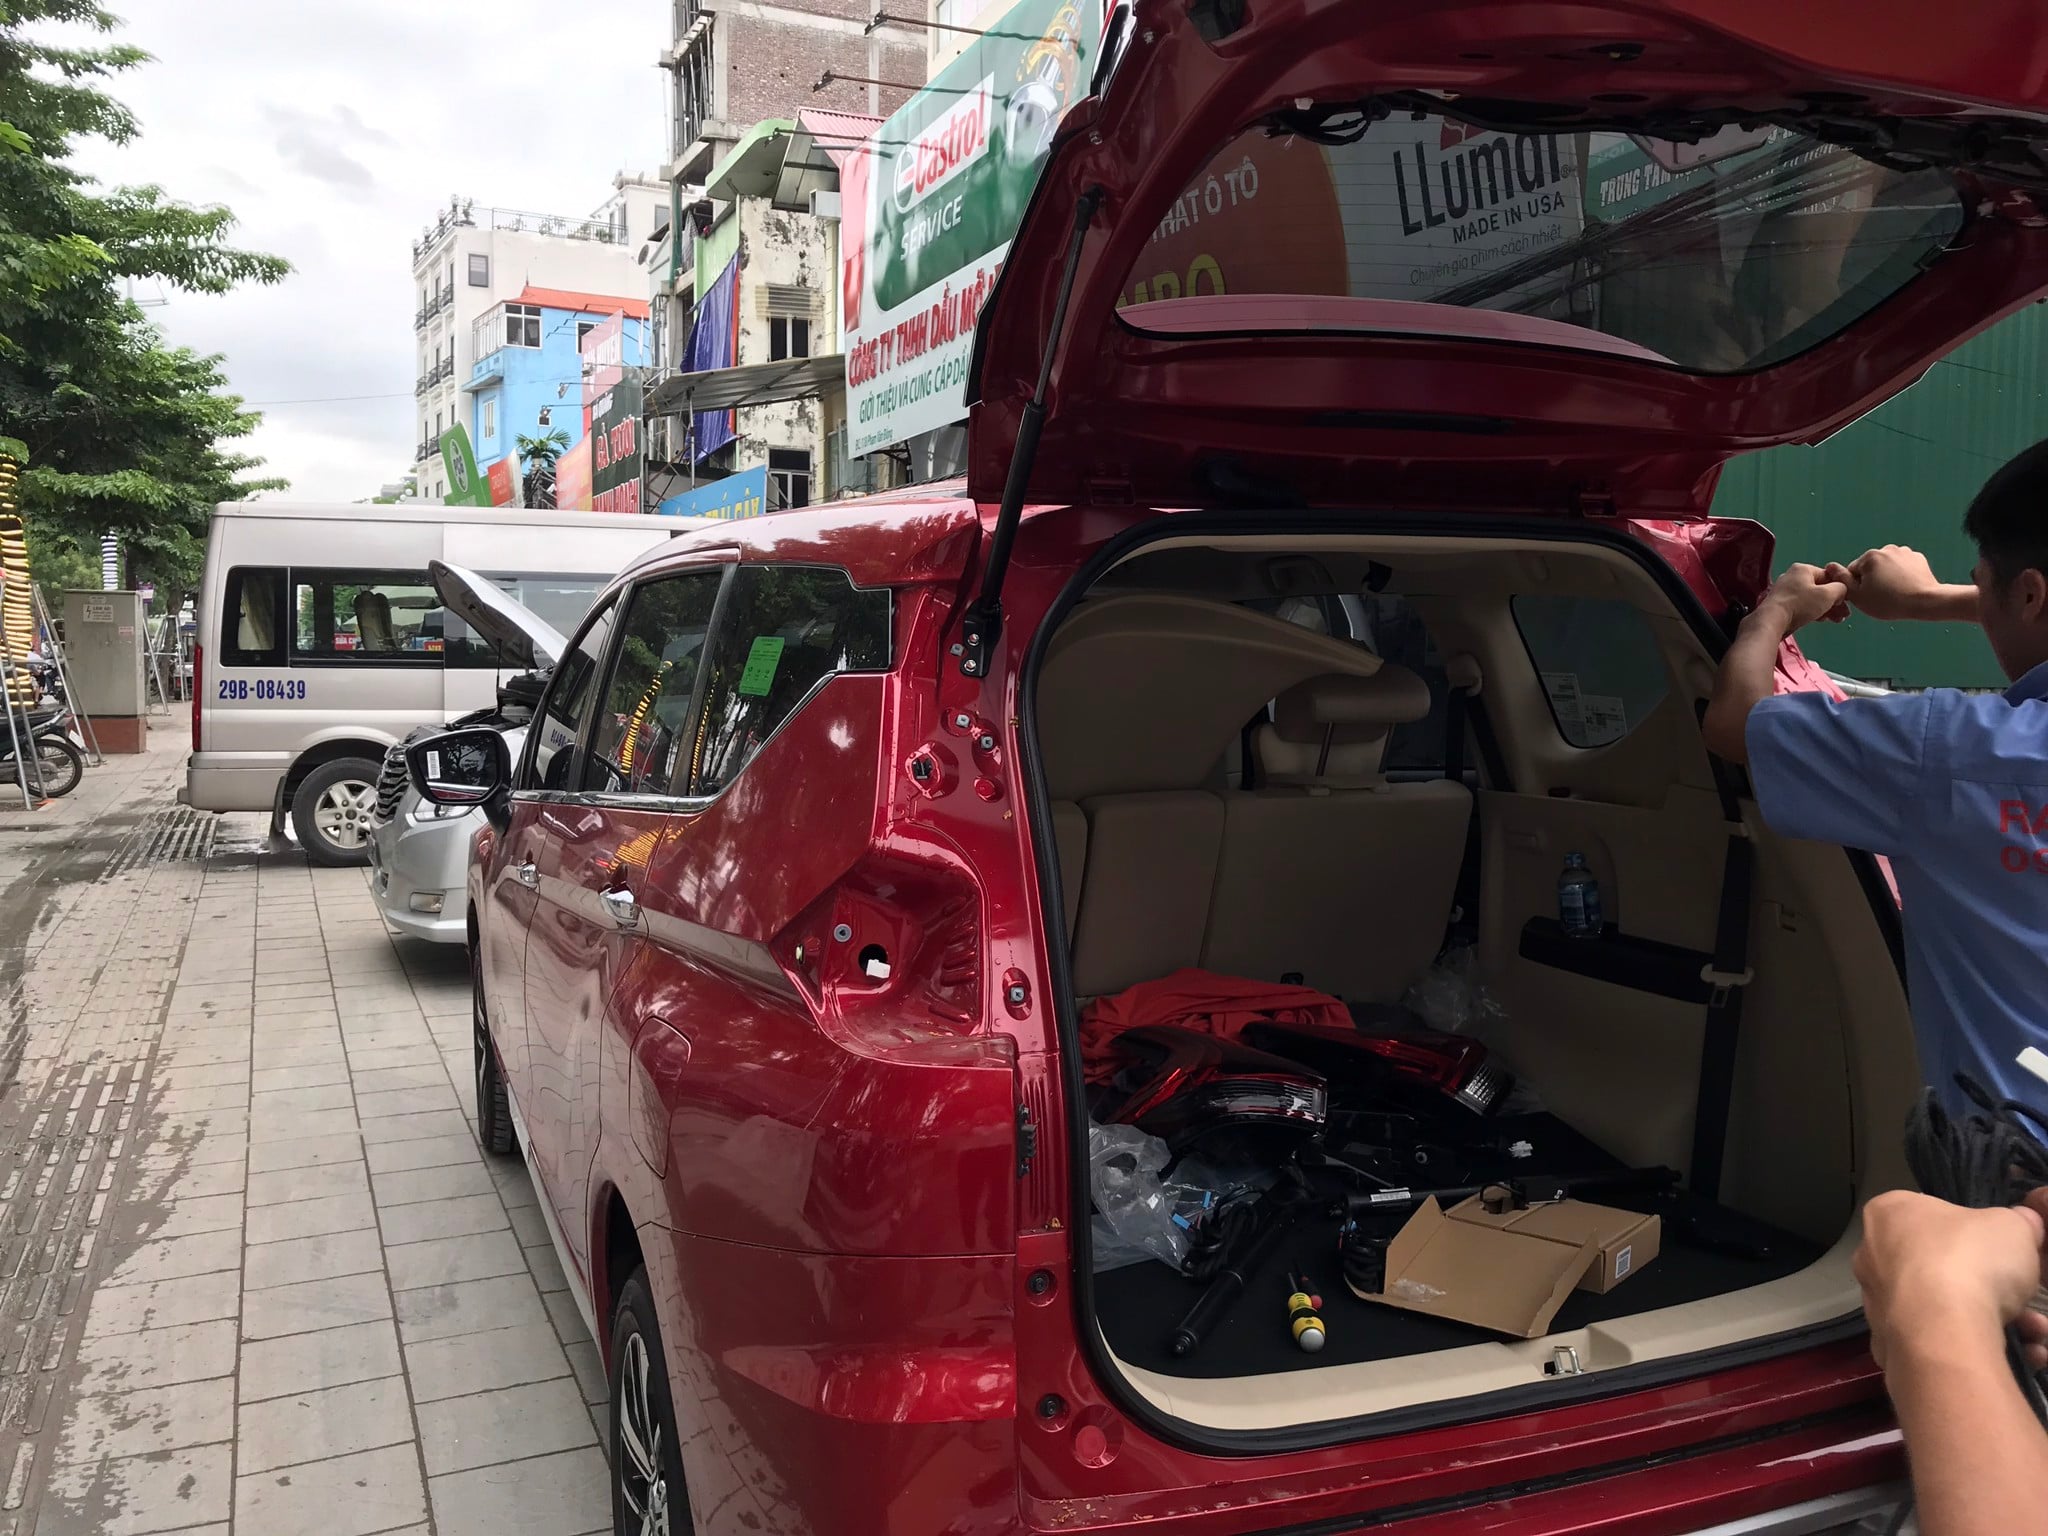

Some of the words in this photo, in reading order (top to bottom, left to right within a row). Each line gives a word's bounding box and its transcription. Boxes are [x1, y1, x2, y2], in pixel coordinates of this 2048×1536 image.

[914, 90, 985, 194] Castrol
[1204, 174, 1223, 216] Ô
[1224, 155, 1259, 207] TÔ
[1599, 167, 1641, 208] TRUNG
[901, 194, 963, 262] SERVICE
[1453, 212, 1499, 245] MADE
[1504, 204, 1522, 227] IN
[1528, 190, 1566, 218] USA
[1471, 246, 1502, 268] phim
[849, 336, 879, 388] CÔNG
[879, 328, 895, 375] TY
[897, 309, 929, 367] TNHH
[930, 281, 958, 349] DẦU
[909, 368, 932, 404] CUNG
[218, 679, 306, 700] 29B-08439
